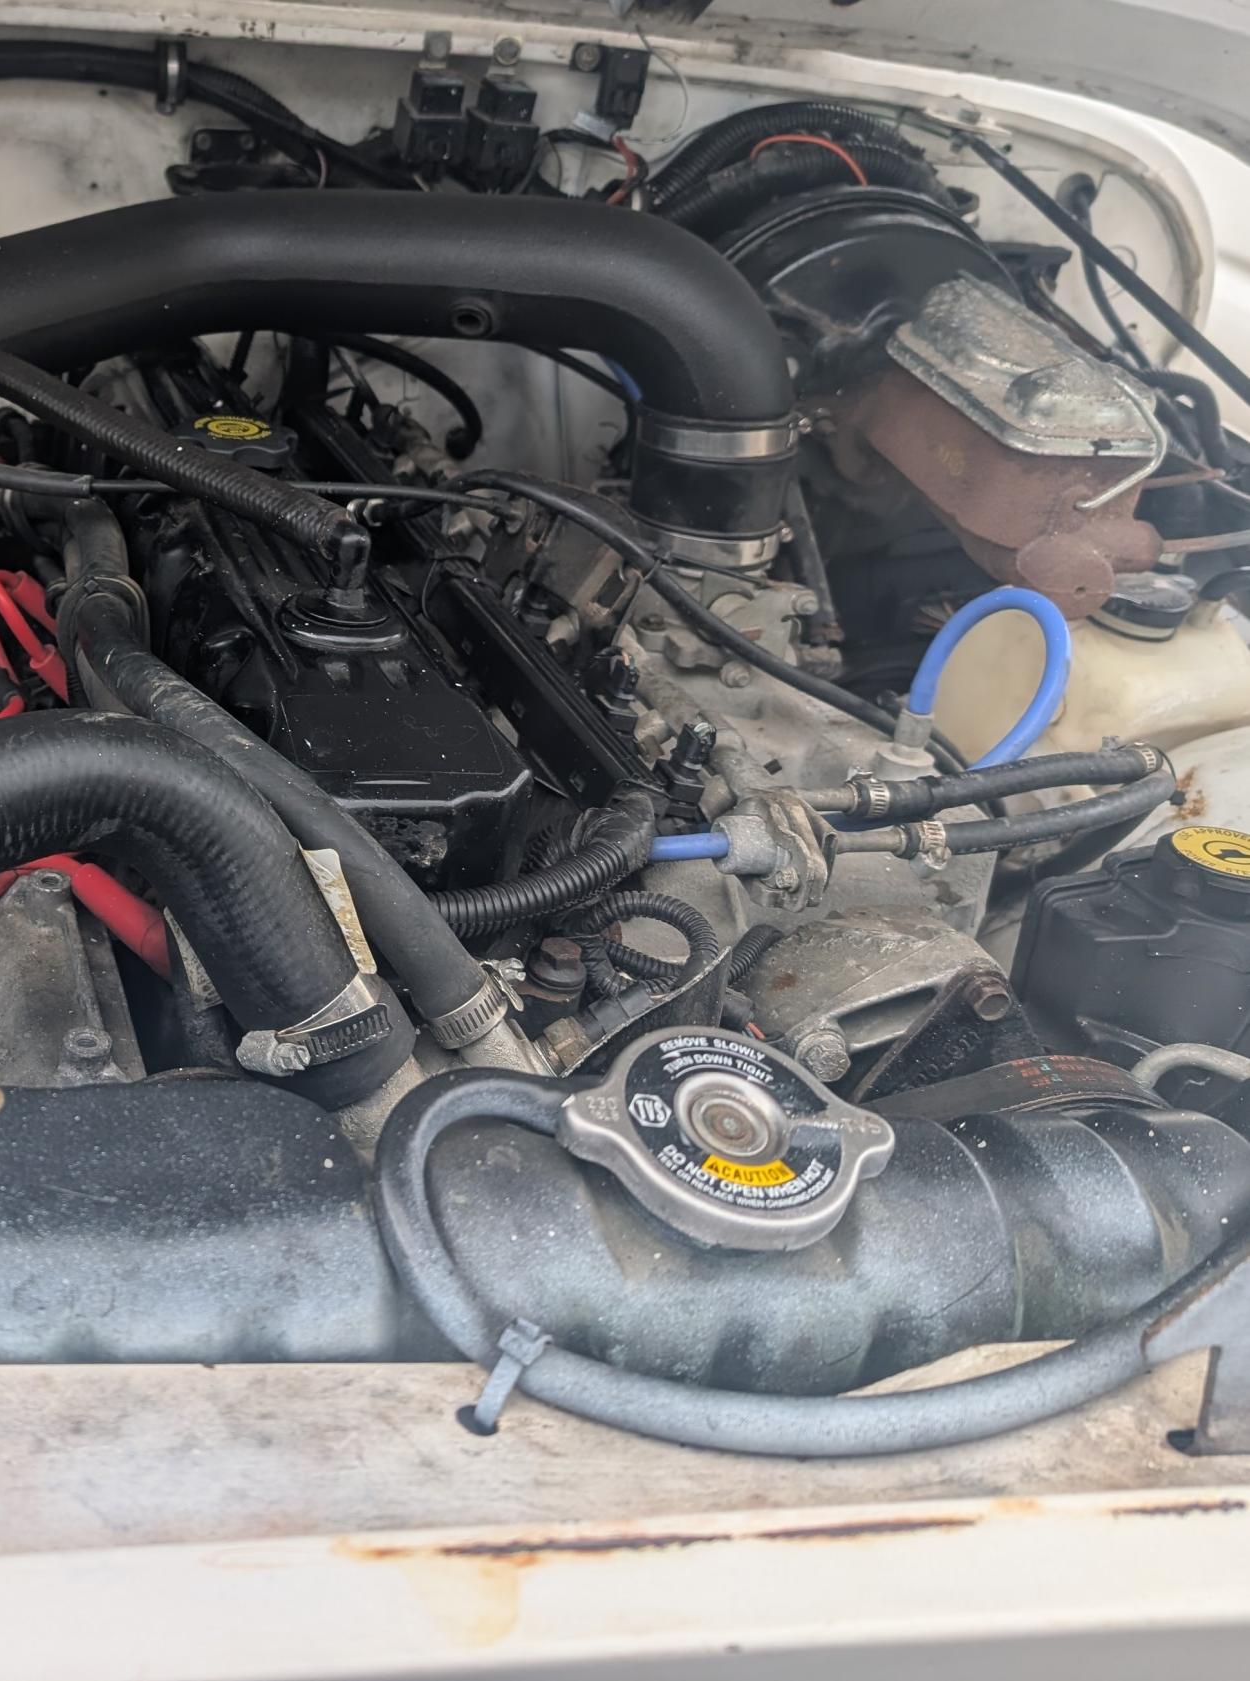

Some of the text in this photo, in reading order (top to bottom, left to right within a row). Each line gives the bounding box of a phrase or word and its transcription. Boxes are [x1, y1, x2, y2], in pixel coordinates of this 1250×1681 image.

[659, 1037, 765, 1061] REMOVE SLOWLY
[663, 1053, 774, 1083] TURN DOWN TIGHT
[663, 1144, 824, 1199] DO NOT OPEN WHEN HOT
[722, 1165, 791, 1184] CAUTION
